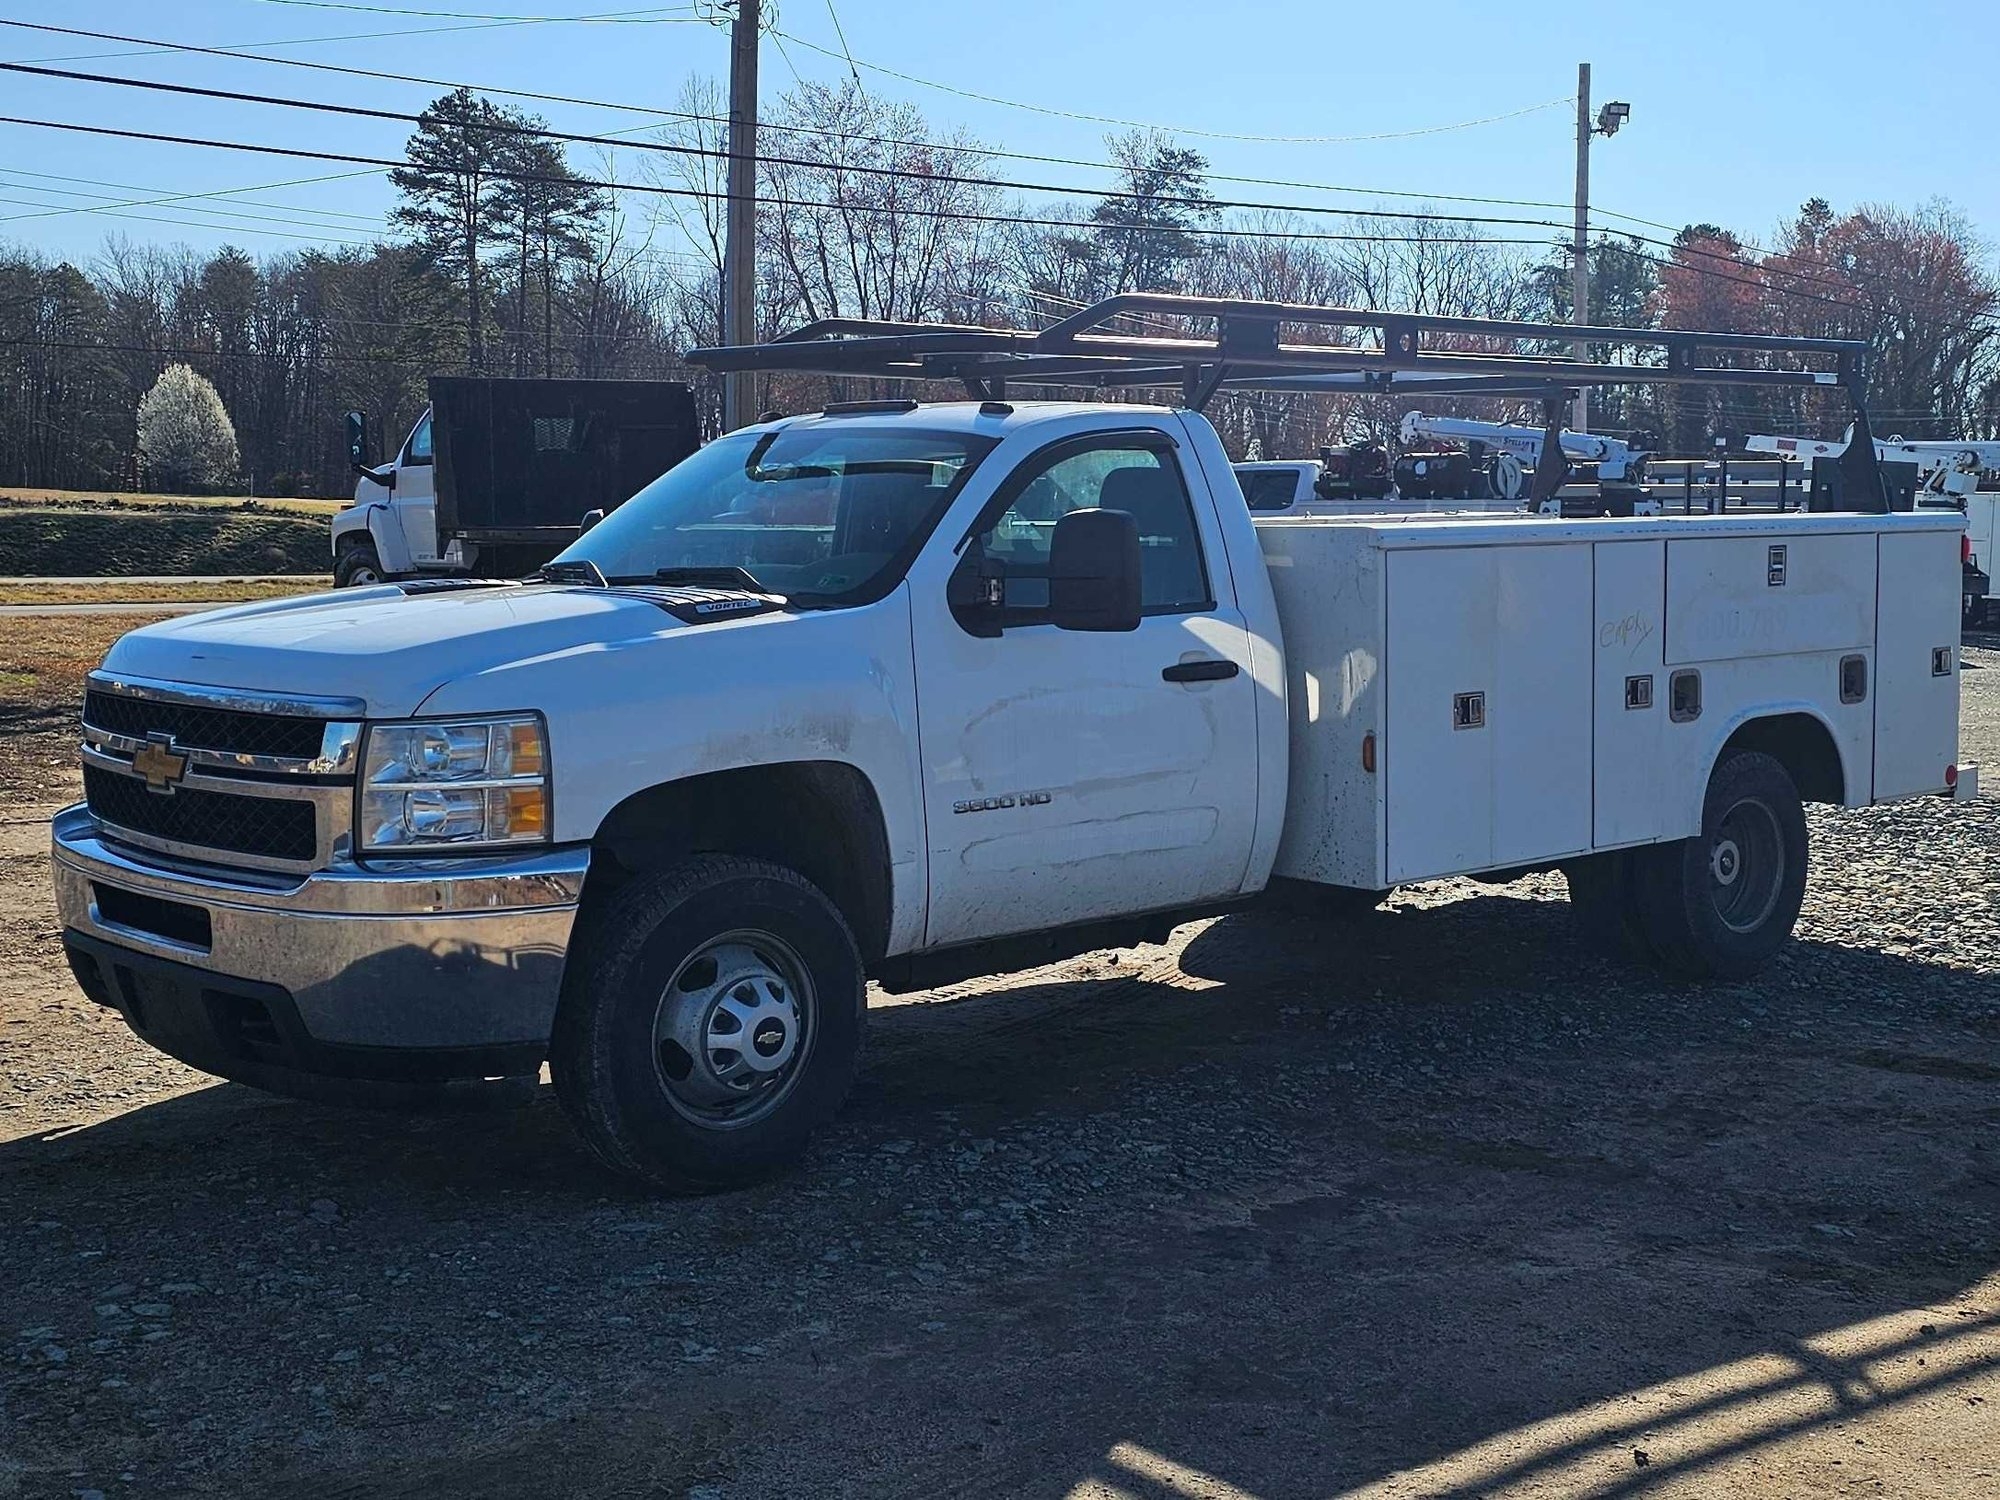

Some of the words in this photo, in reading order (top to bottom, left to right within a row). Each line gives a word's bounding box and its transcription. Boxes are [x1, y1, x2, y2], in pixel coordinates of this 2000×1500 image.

[706, 600, 751, 611] VORTEC
[953, 798, 1015, 814] 3500
[1020, 792, 1052, 807] HD
